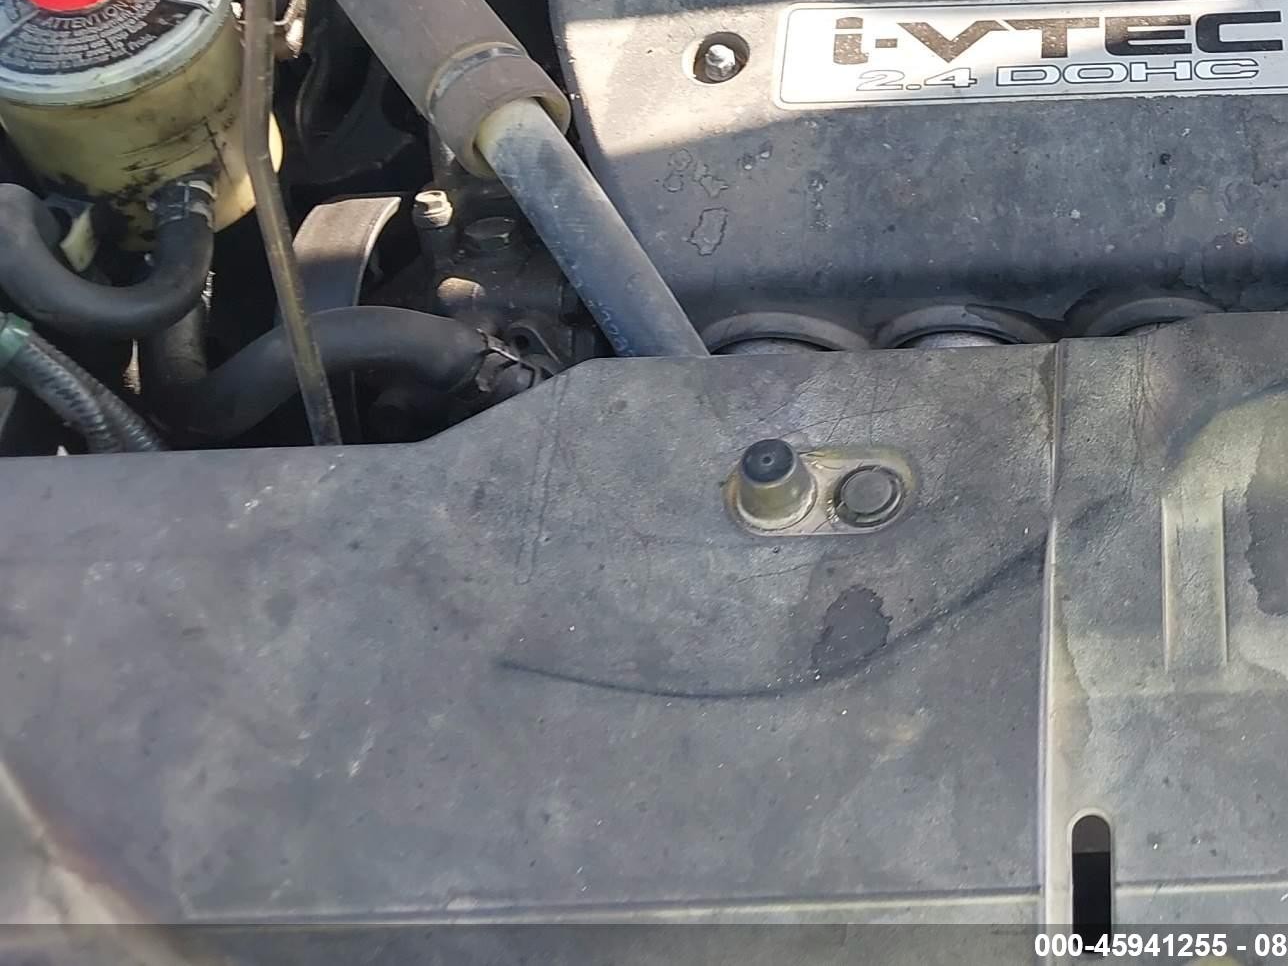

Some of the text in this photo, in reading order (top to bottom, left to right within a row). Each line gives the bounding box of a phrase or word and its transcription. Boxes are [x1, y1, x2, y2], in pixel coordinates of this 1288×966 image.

[42, 0, 129, 30] ATTENTION
[832, 10, 1284, 65] i-VTEC
[855, 58, 1260, 92] 2.4 DOHC
